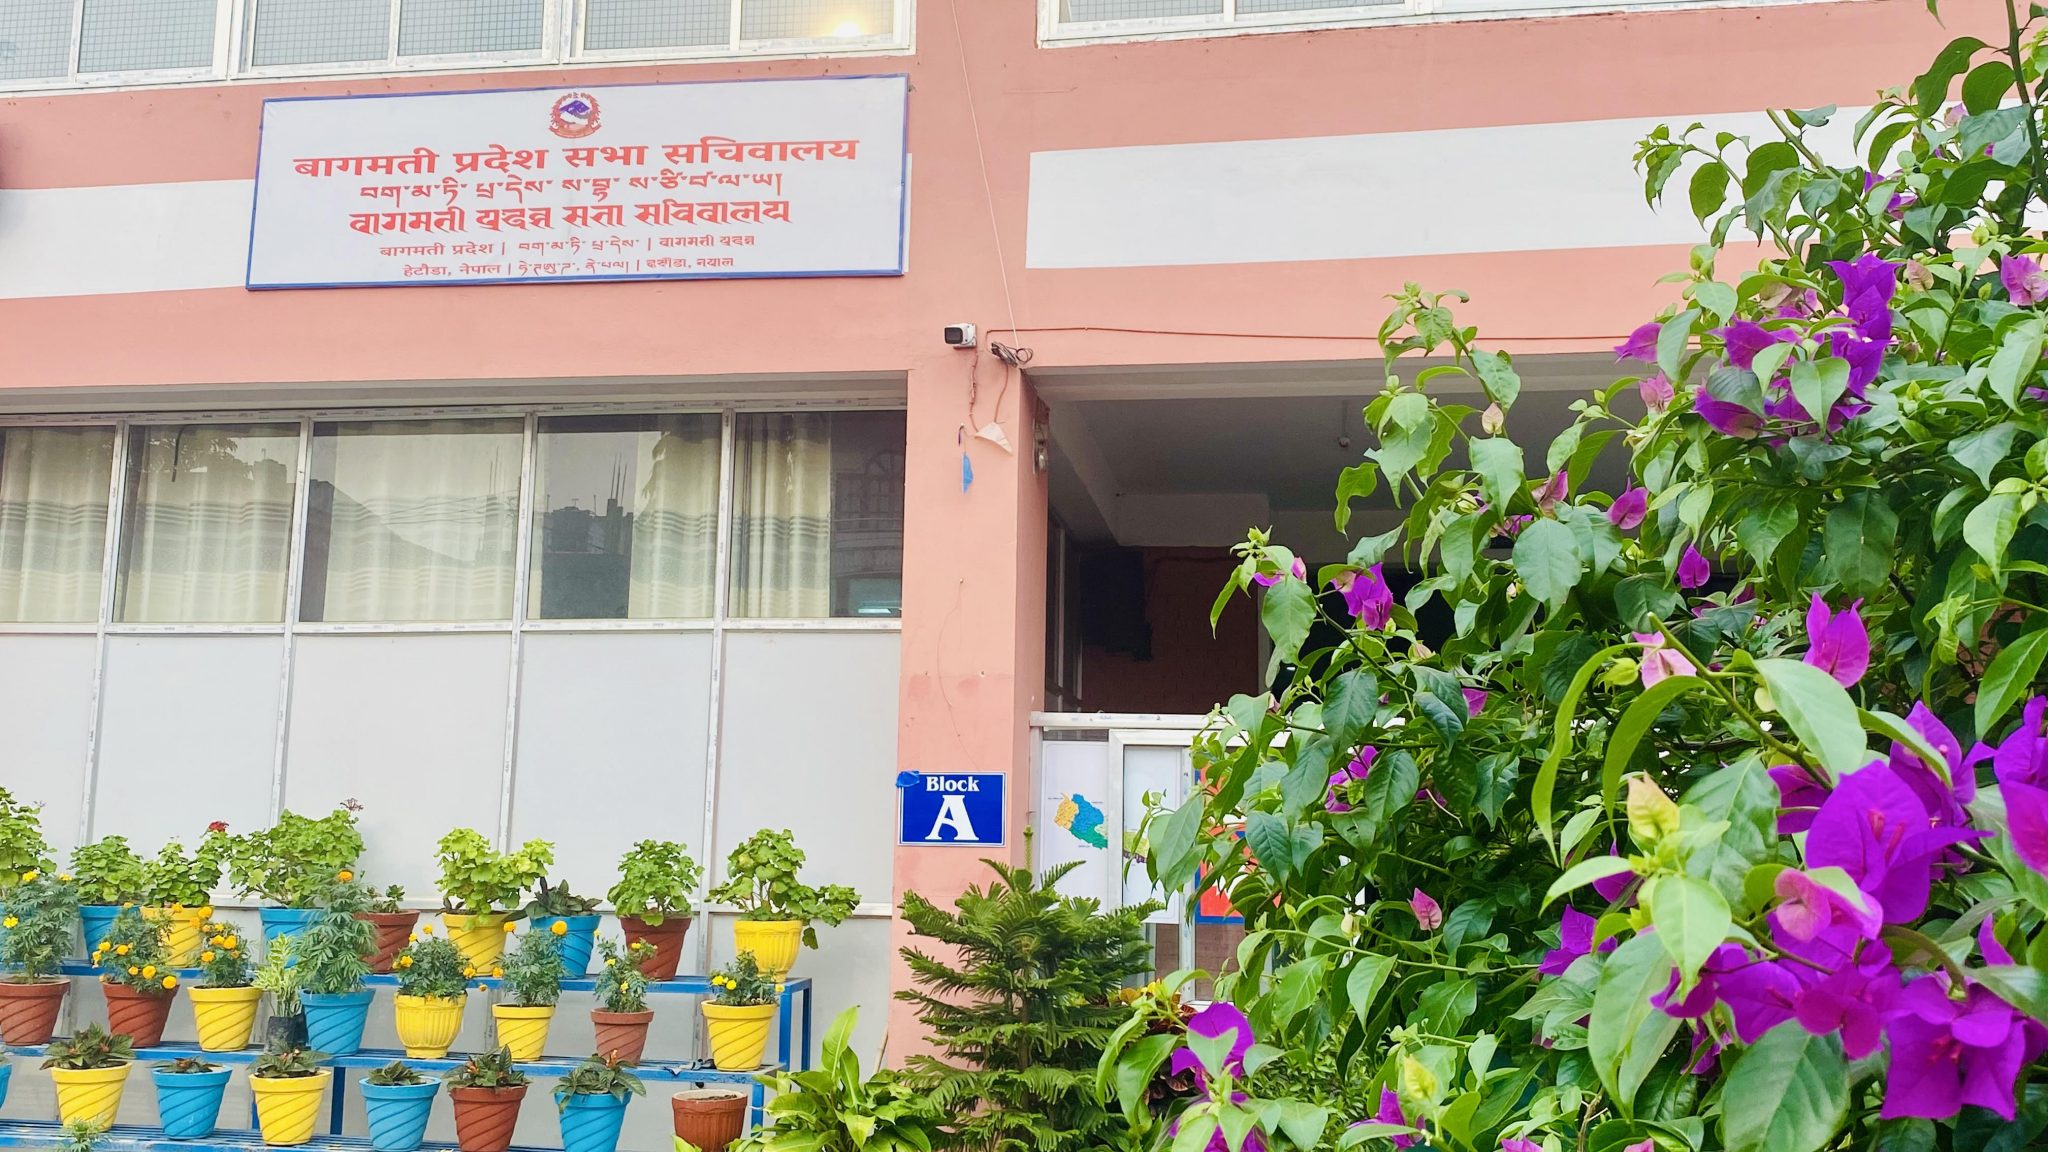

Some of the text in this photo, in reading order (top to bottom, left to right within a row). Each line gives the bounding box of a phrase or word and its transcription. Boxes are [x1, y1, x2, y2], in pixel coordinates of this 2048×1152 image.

[293, 135, 860, 178] बागमती प्रदेश सभा सचिवालय
[379, 242, 445, 256] बागमती
[452, 241, 494, 255] प्रदेश
[459, 263, 502, 276] नेपाल
[926, 775, 980, 792] Block
[924, 794, 980, 841] A
